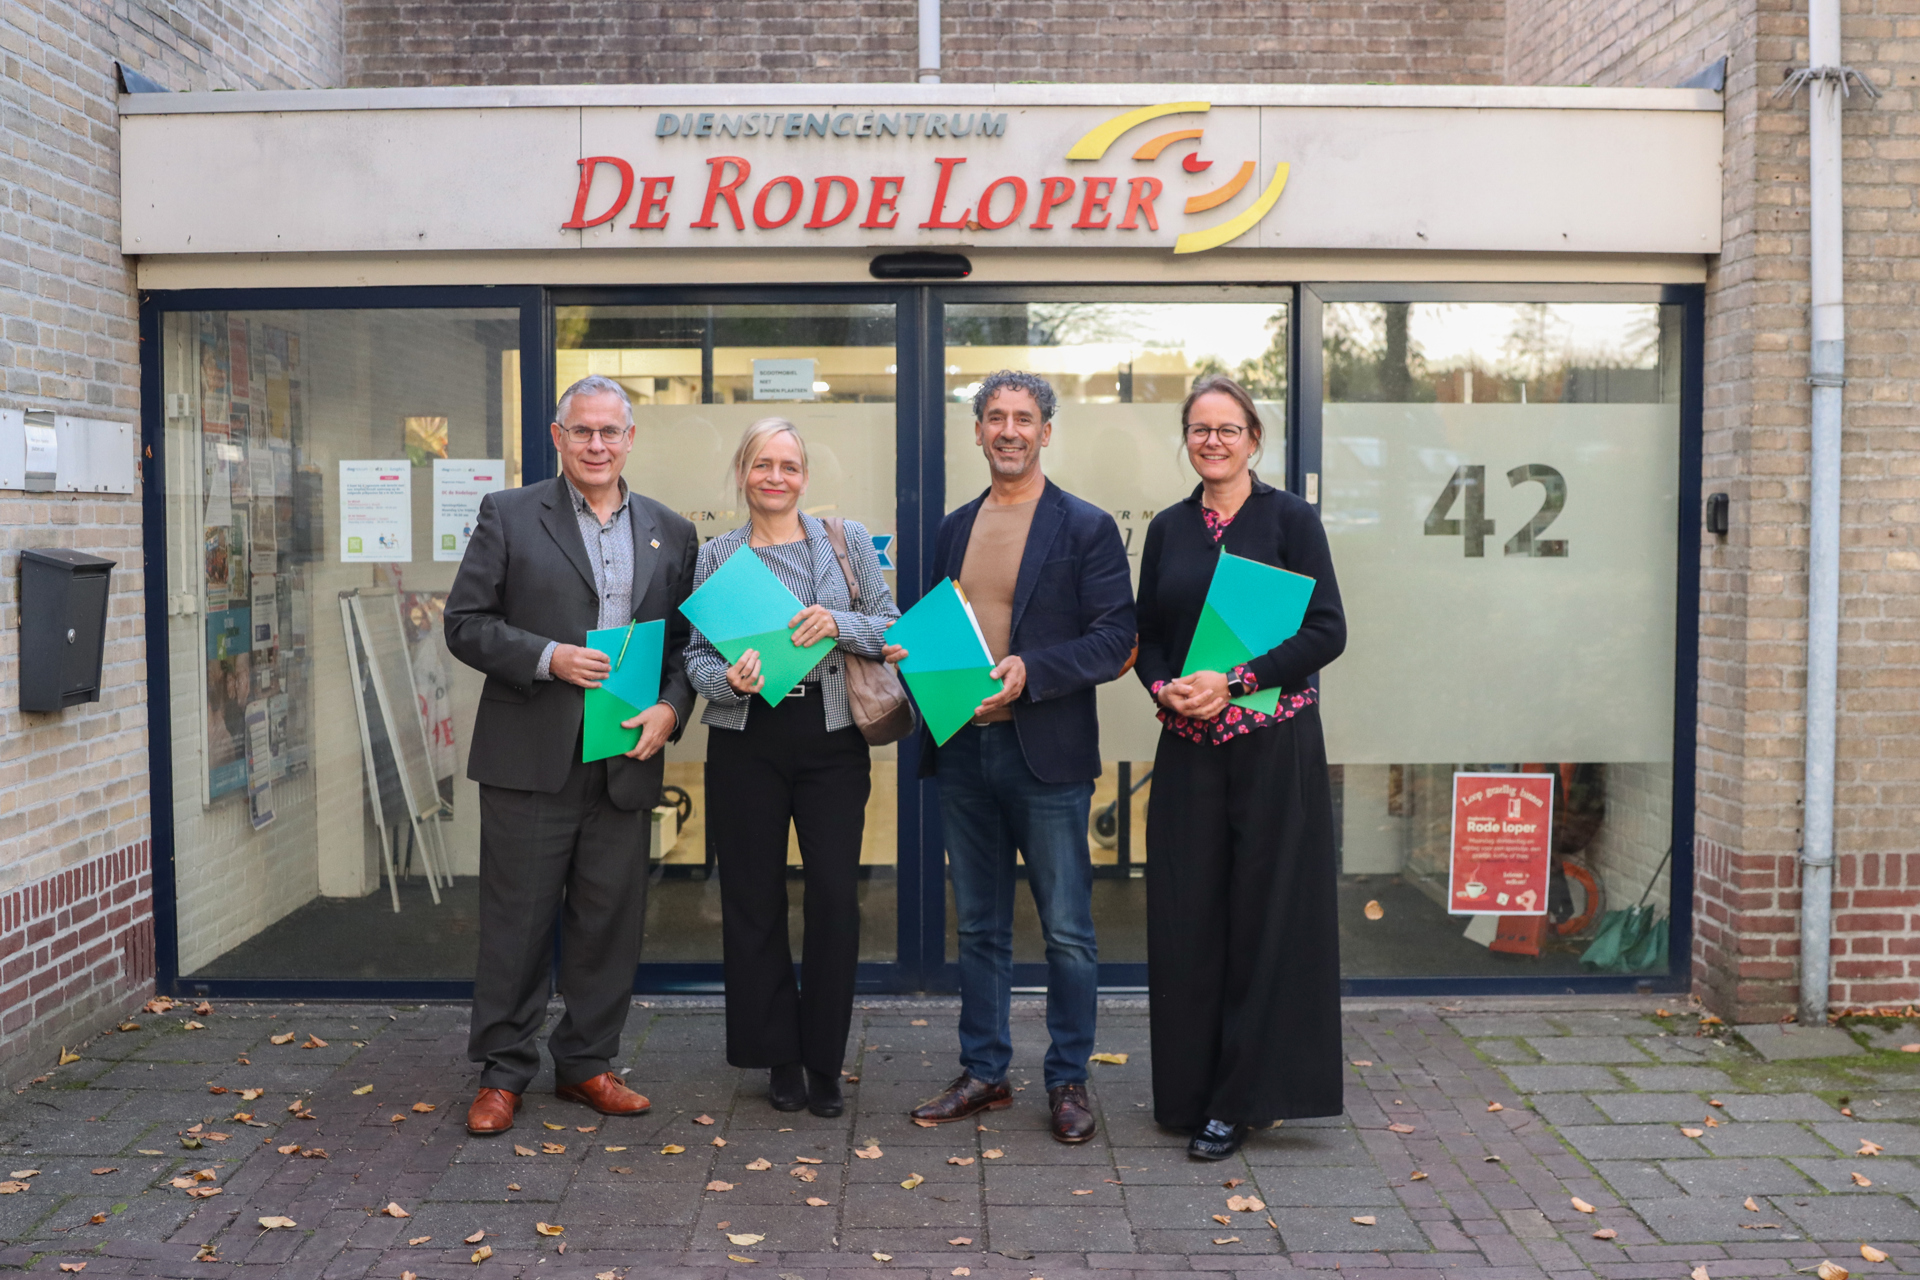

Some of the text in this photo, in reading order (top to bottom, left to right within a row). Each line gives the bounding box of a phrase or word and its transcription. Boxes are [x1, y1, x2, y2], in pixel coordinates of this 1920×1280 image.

[655, 112, 1008, 138] DIENSTENCENTRUM
[561, 155, 1164, 231] DE RODE LOPER
[1424, 463, 1569, 558] 42
[1462, 791, 1483, 807] Loop
[1467, 821, 1537, 836] Rode loper
